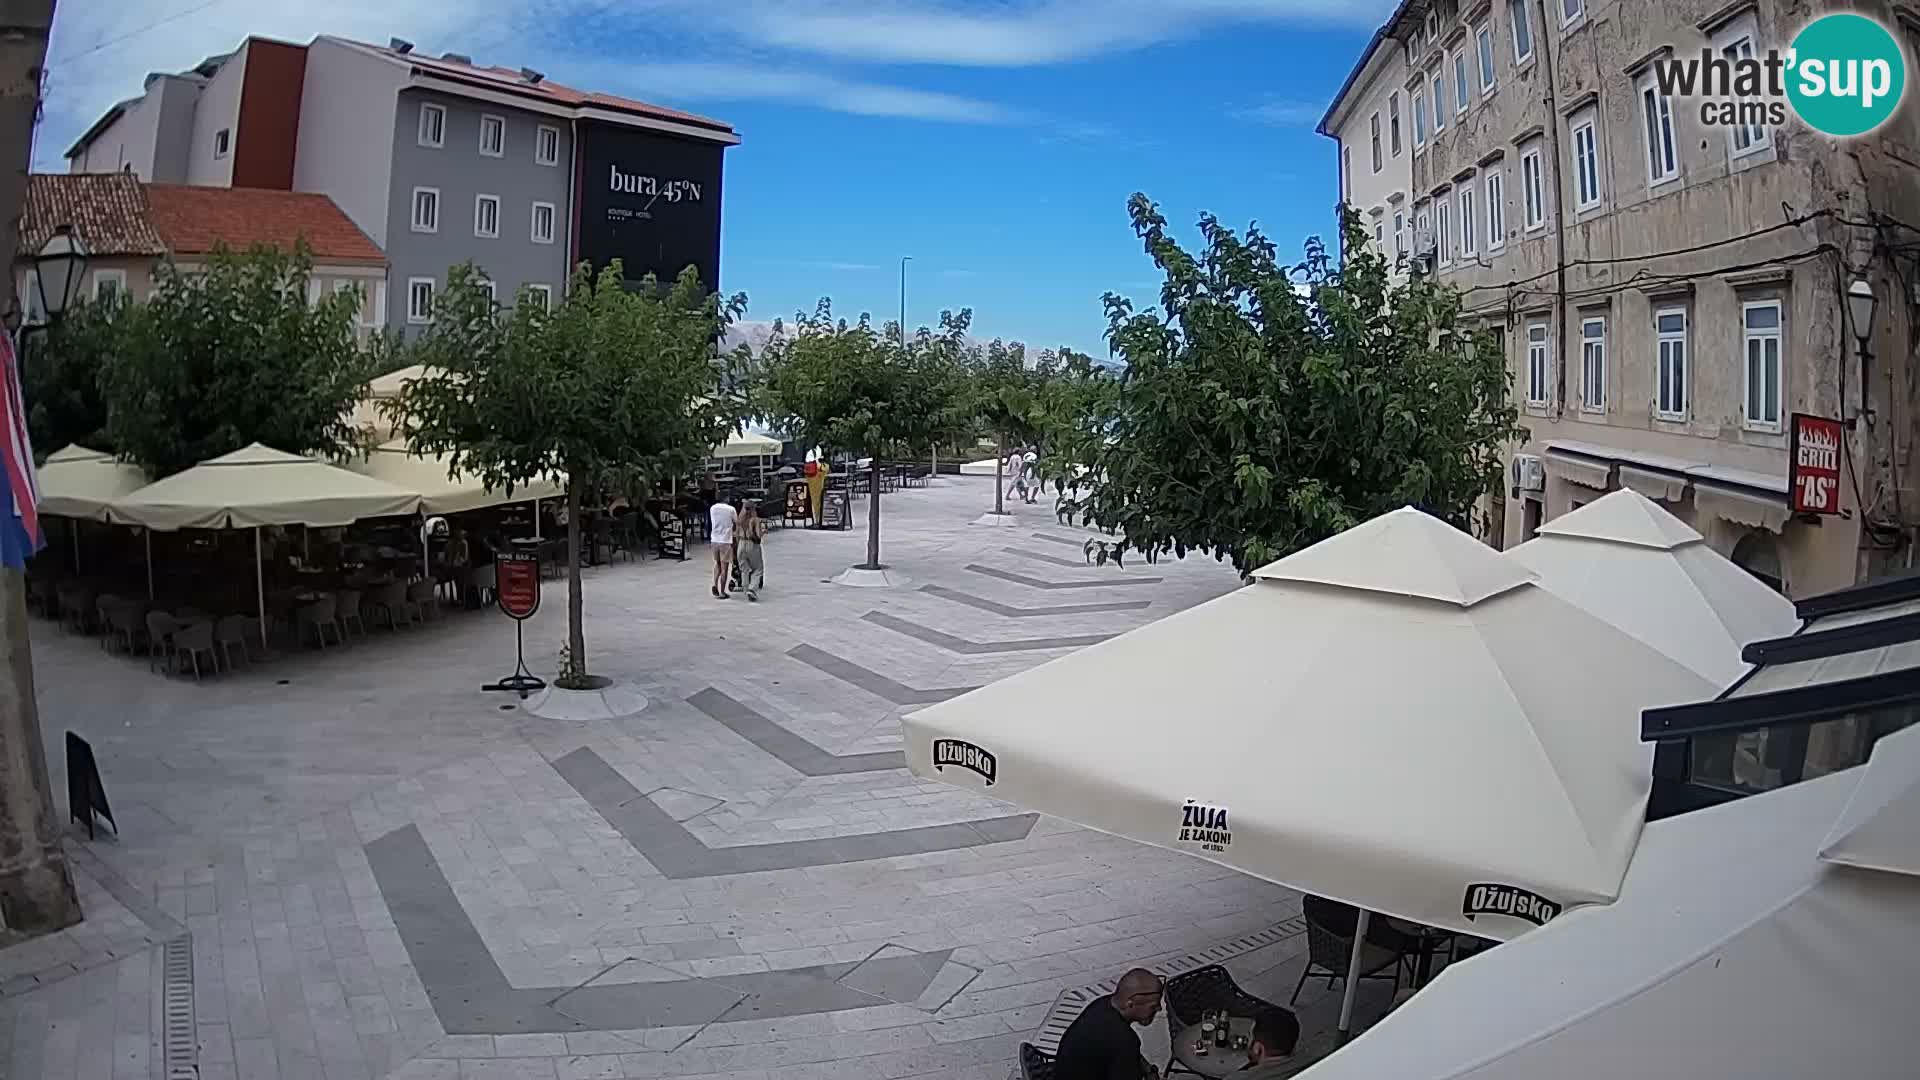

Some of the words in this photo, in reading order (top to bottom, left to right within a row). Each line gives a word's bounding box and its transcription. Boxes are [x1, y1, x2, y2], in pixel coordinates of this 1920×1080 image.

[610, 164, 657, 196] bura
[1798, 446, 1838, 471] GRILL
[938, 741, 991, 775] Ožujsko
[1182, 799, 1228, 831] ŽUJA
[1178, 828, 1190, 841] JE
[1192, 829, 1232, 845] ZAKON!
[1471, 886, 1554, 924] Ožujsko
